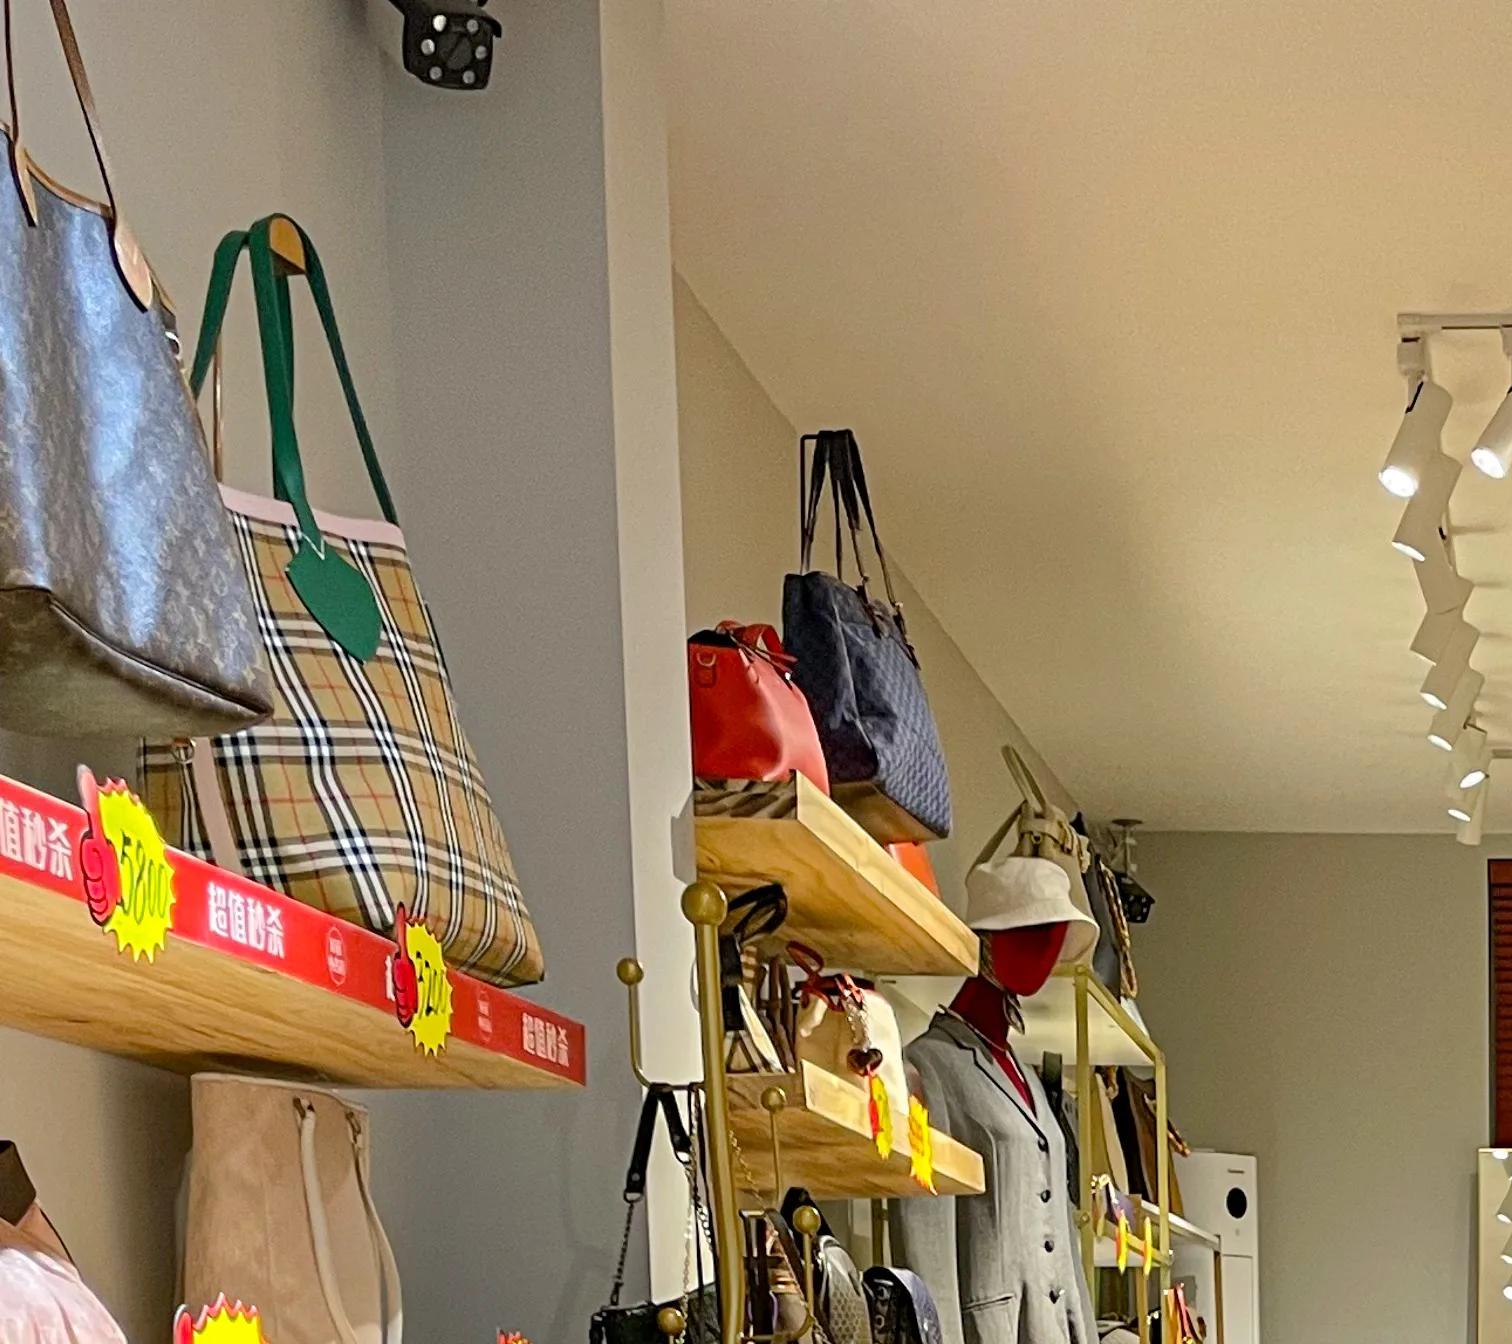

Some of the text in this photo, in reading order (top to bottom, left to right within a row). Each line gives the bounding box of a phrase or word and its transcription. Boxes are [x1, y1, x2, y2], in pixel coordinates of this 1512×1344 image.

[208, 881, 285, 959] 超值秒杀
[522, 1012, 570, 1067] 超值秒杀
